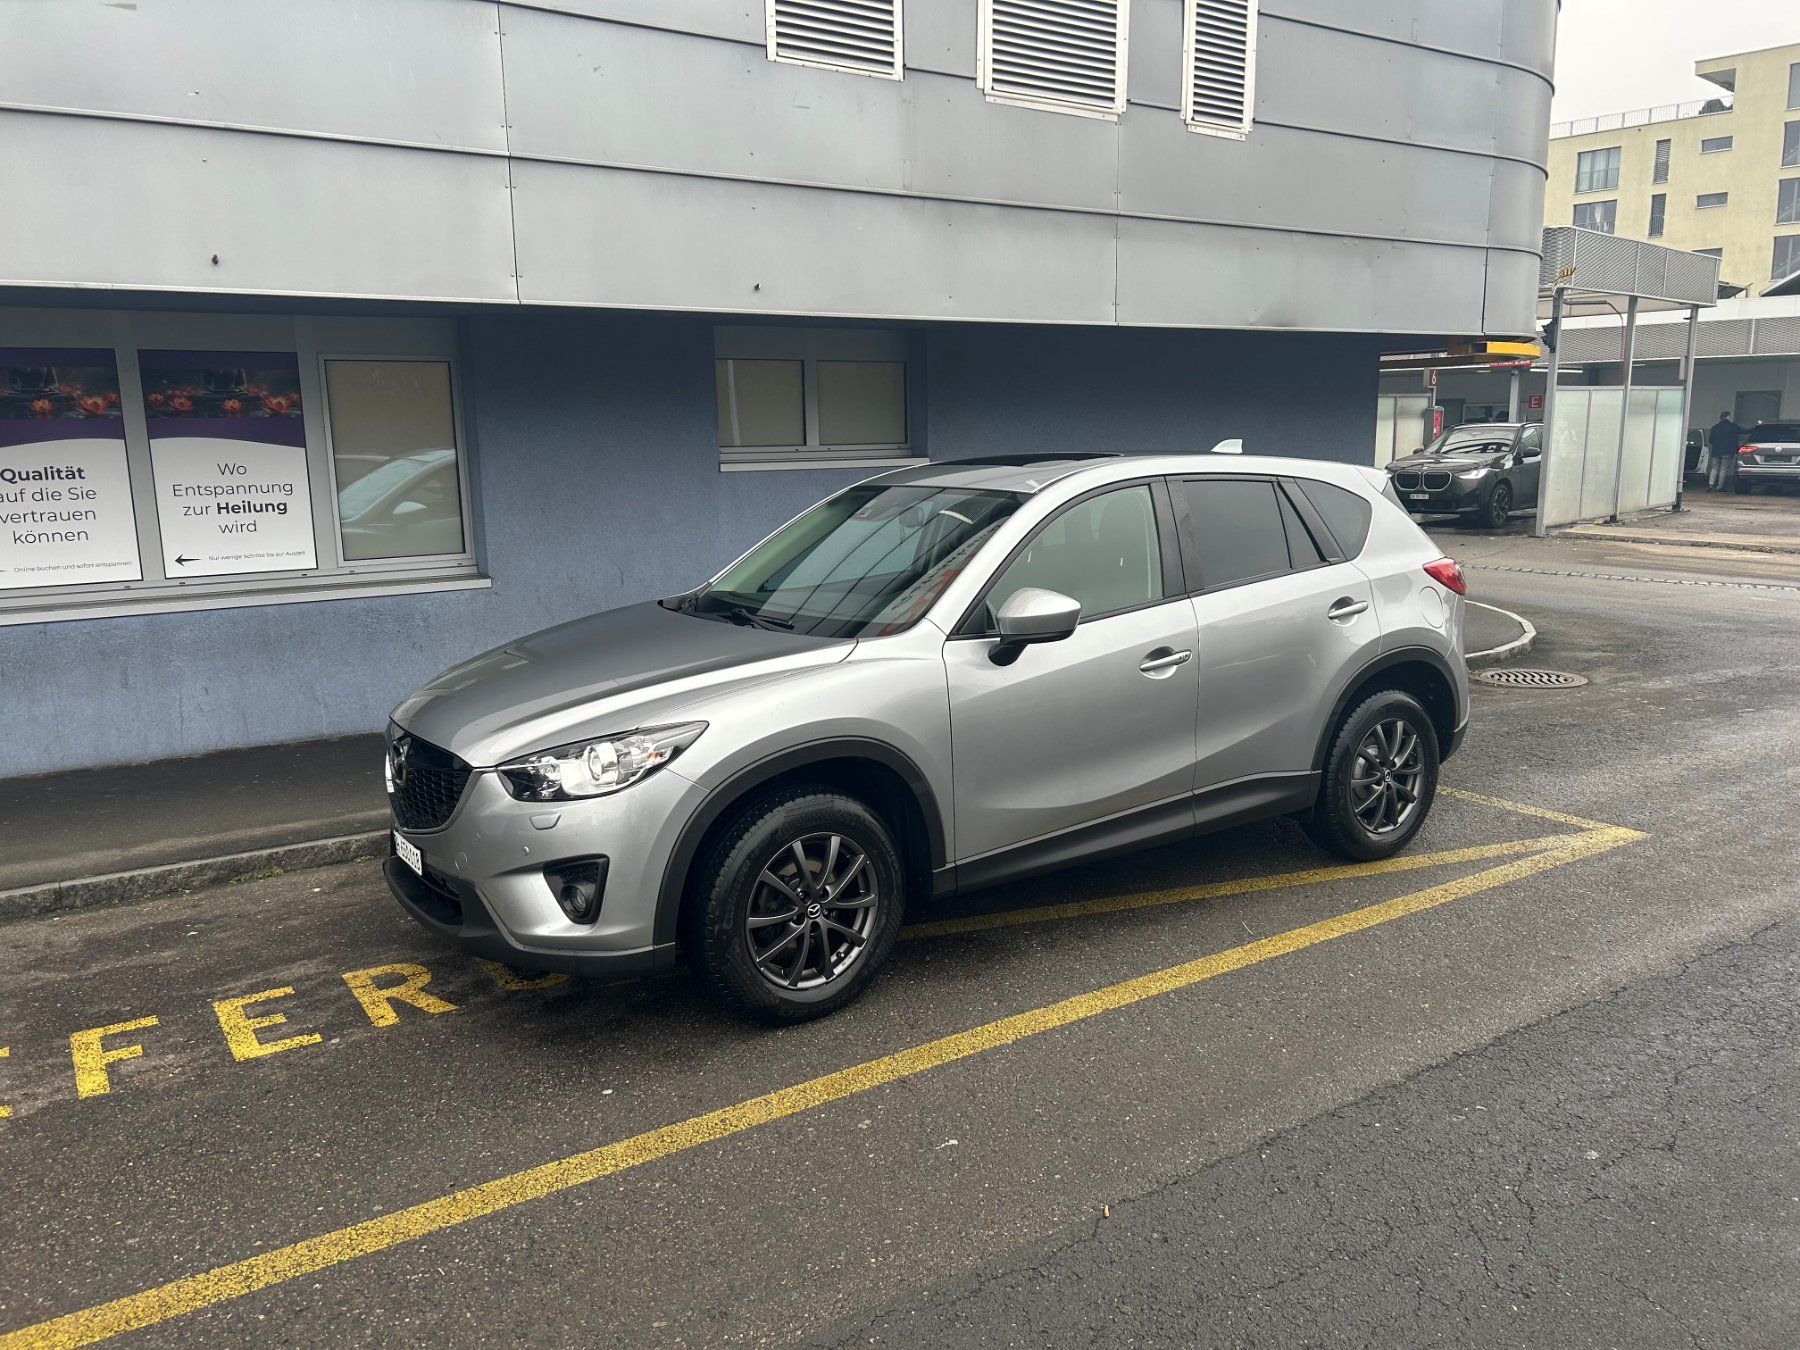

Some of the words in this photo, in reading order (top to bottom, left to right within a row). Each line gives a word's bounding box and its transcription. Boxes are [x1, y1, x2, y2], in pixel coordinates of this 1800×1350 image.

[1431, 370, 1437, 385] 6
[1531, 396, 1539, 408] E
[0, 466, 86, 485] Qualität
[217, 463, 247, 475] Wo
[31, 487, 62, 502] die
[68, 486, 96, 501] Sie
[172, 483, 293, 498] Entspannung
[182, 505, 211, 516] zur
[217, 500, 287, 515] Heilung
[0, 510, 96, 524] vertrauen
[219, 520, 257, 533] wird
[13, 530, 88, 544] können
[36, 564, 61, 572] buchen
